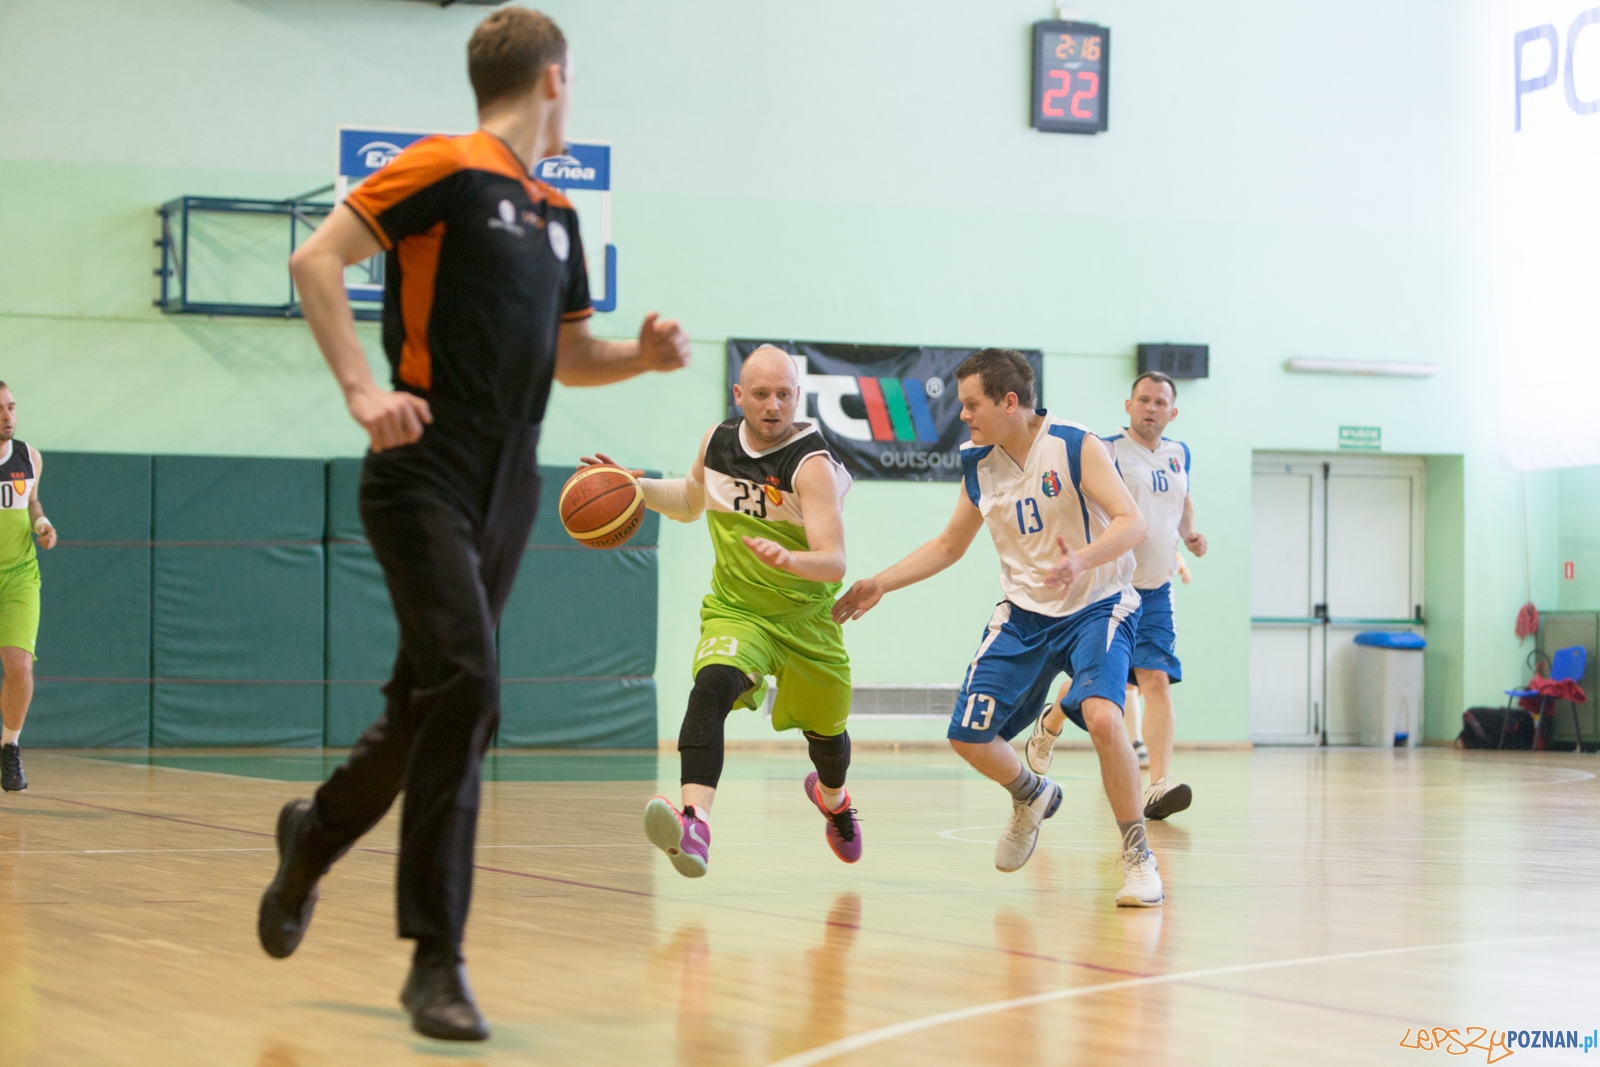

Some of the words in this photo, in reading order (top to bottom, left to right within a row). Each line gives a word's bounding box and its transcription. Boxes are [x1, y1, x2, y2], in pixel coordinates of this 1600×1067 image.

[1055, 34, 1101, 61] 2:16
[1042, 70, 1099, 118] 22
[541, 163, 596, 181] Enea
[1151, 470, 1169, 493] 16
[733, 481, 768, 519] 23
[1015, 497, 1044, 535] 13
[590, 518, 639, 547] molten
[696, 636, 738, 661] 23
[961, 693, 996, 731] 13
